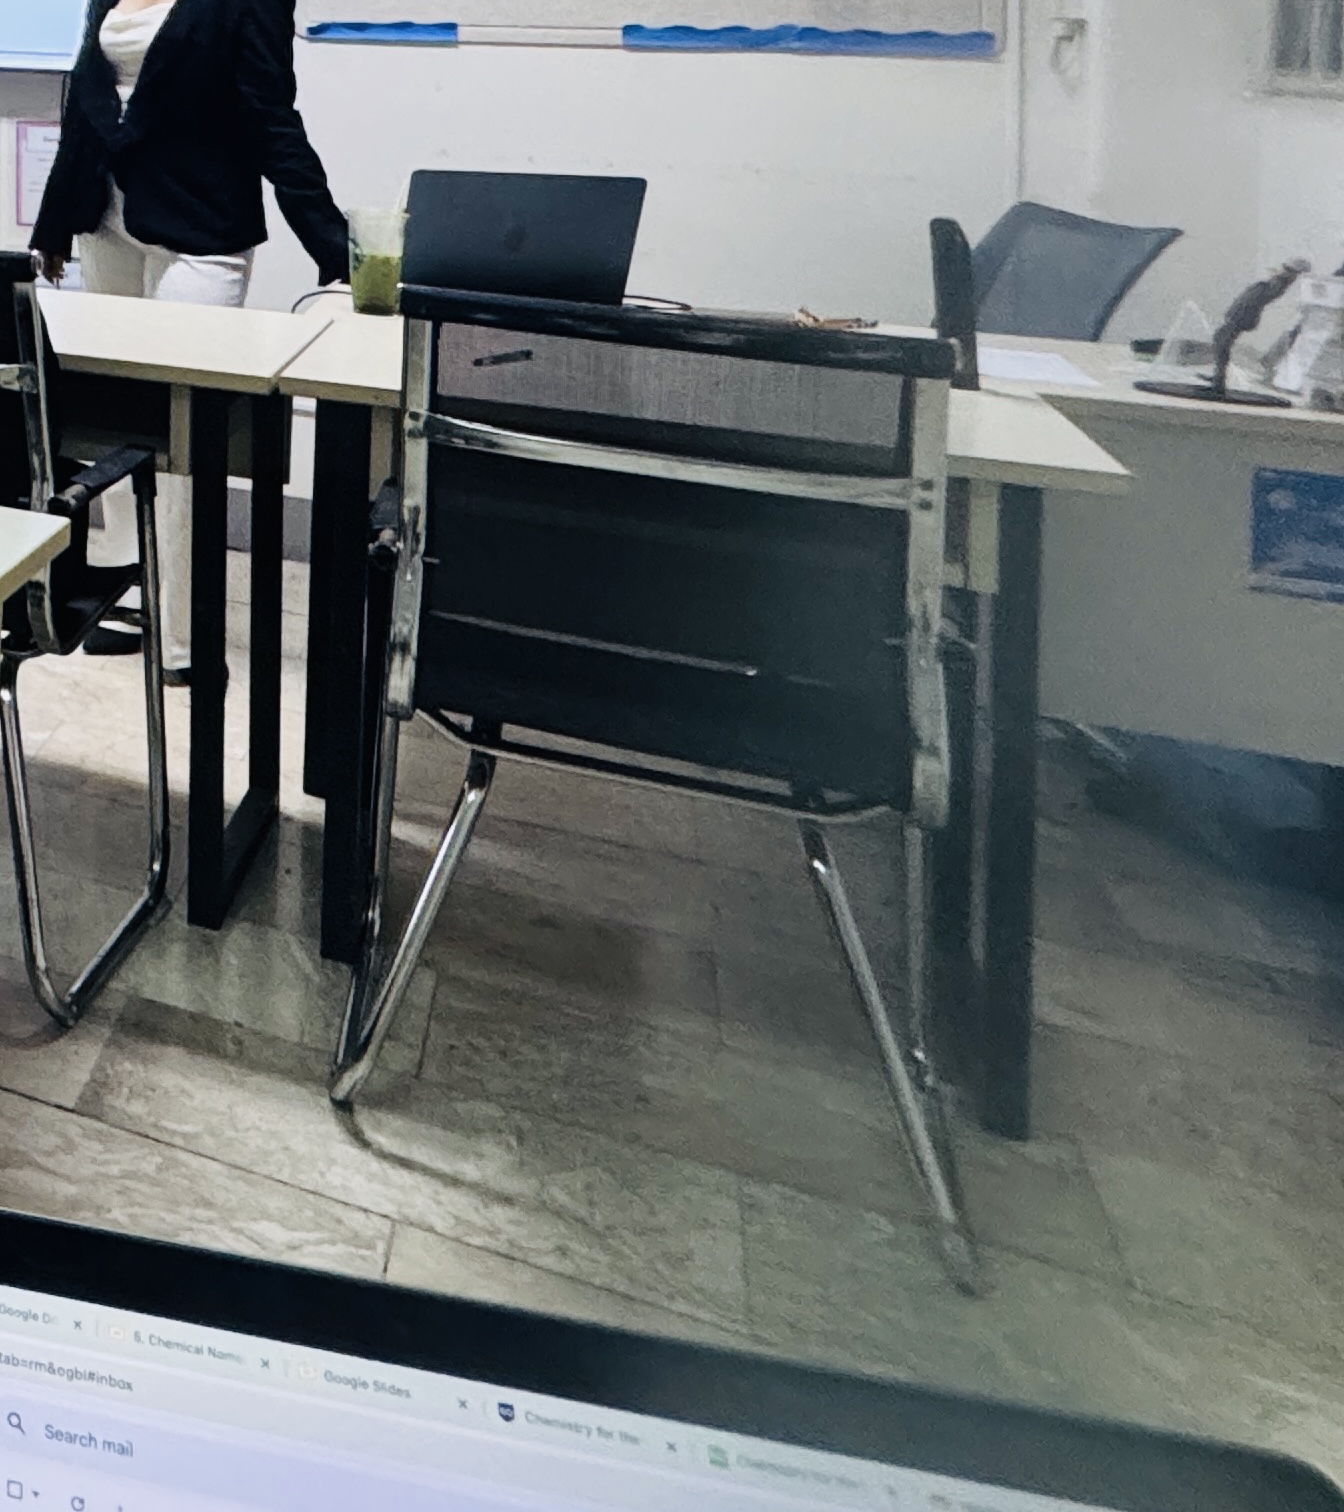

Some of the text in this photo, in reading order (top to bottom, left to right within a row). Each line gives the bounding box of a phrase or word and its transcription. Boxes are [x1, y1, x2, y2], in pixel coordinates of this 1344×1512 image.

[149, 1333, 204, 1356] Chemical
[324, 1370, 412, 1399] Google Slides
[44, 1424, 134, 1458] Search mail
[596, 1426, 614, 1439] for
